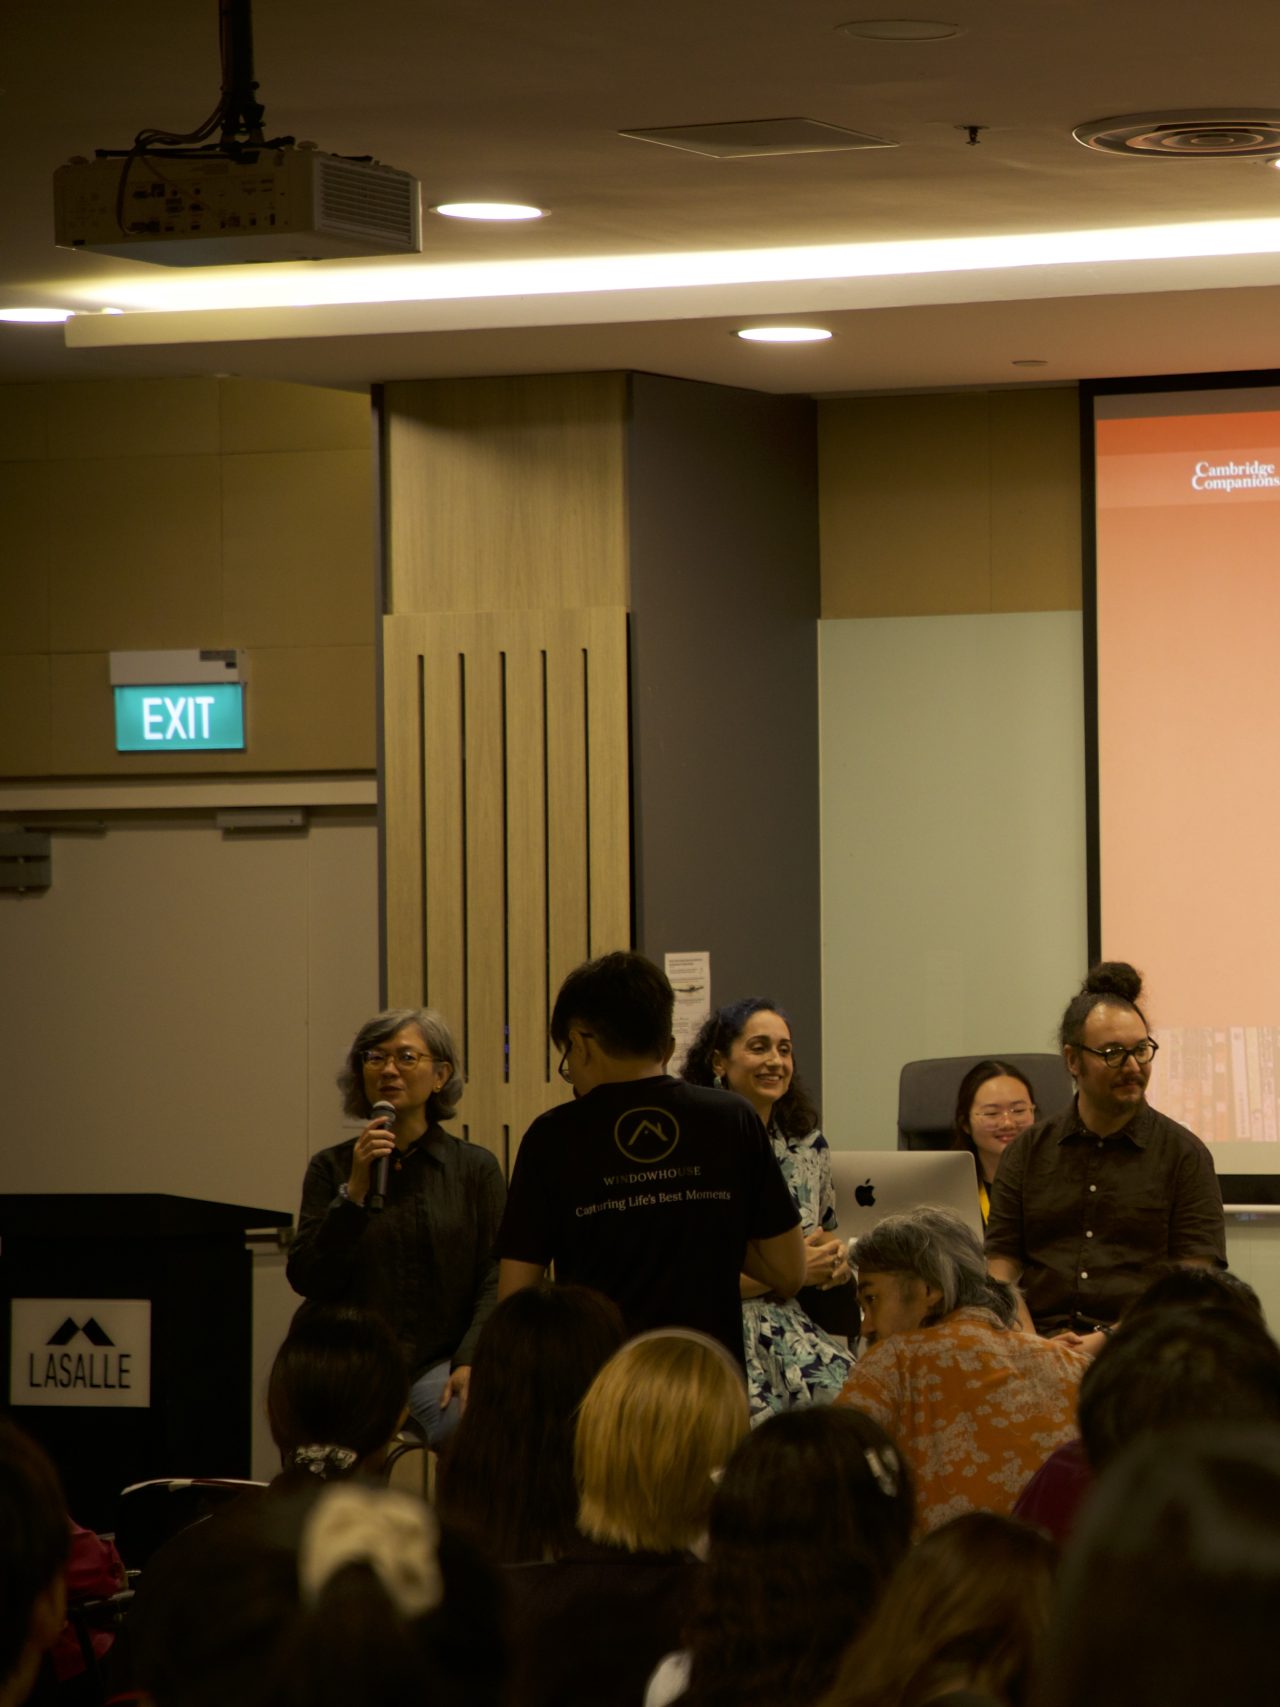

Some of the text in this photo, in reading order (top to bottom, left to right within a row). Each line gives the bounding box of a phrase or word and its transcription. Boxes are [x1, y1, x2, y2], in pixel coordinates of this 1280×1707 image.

[1195, 461, 1276, 479] Cambridge
[1191, 473, 1280, 491] Companions
[142, 696, 215, 740] EXIT
[603, 1166, 702, 1186] WINDOWHOUSE
[659, 1190, 683, 1203] Best
[686, 1189, 731, 1201] Moments
[29, 1353, 131, 1389] LASALLE
